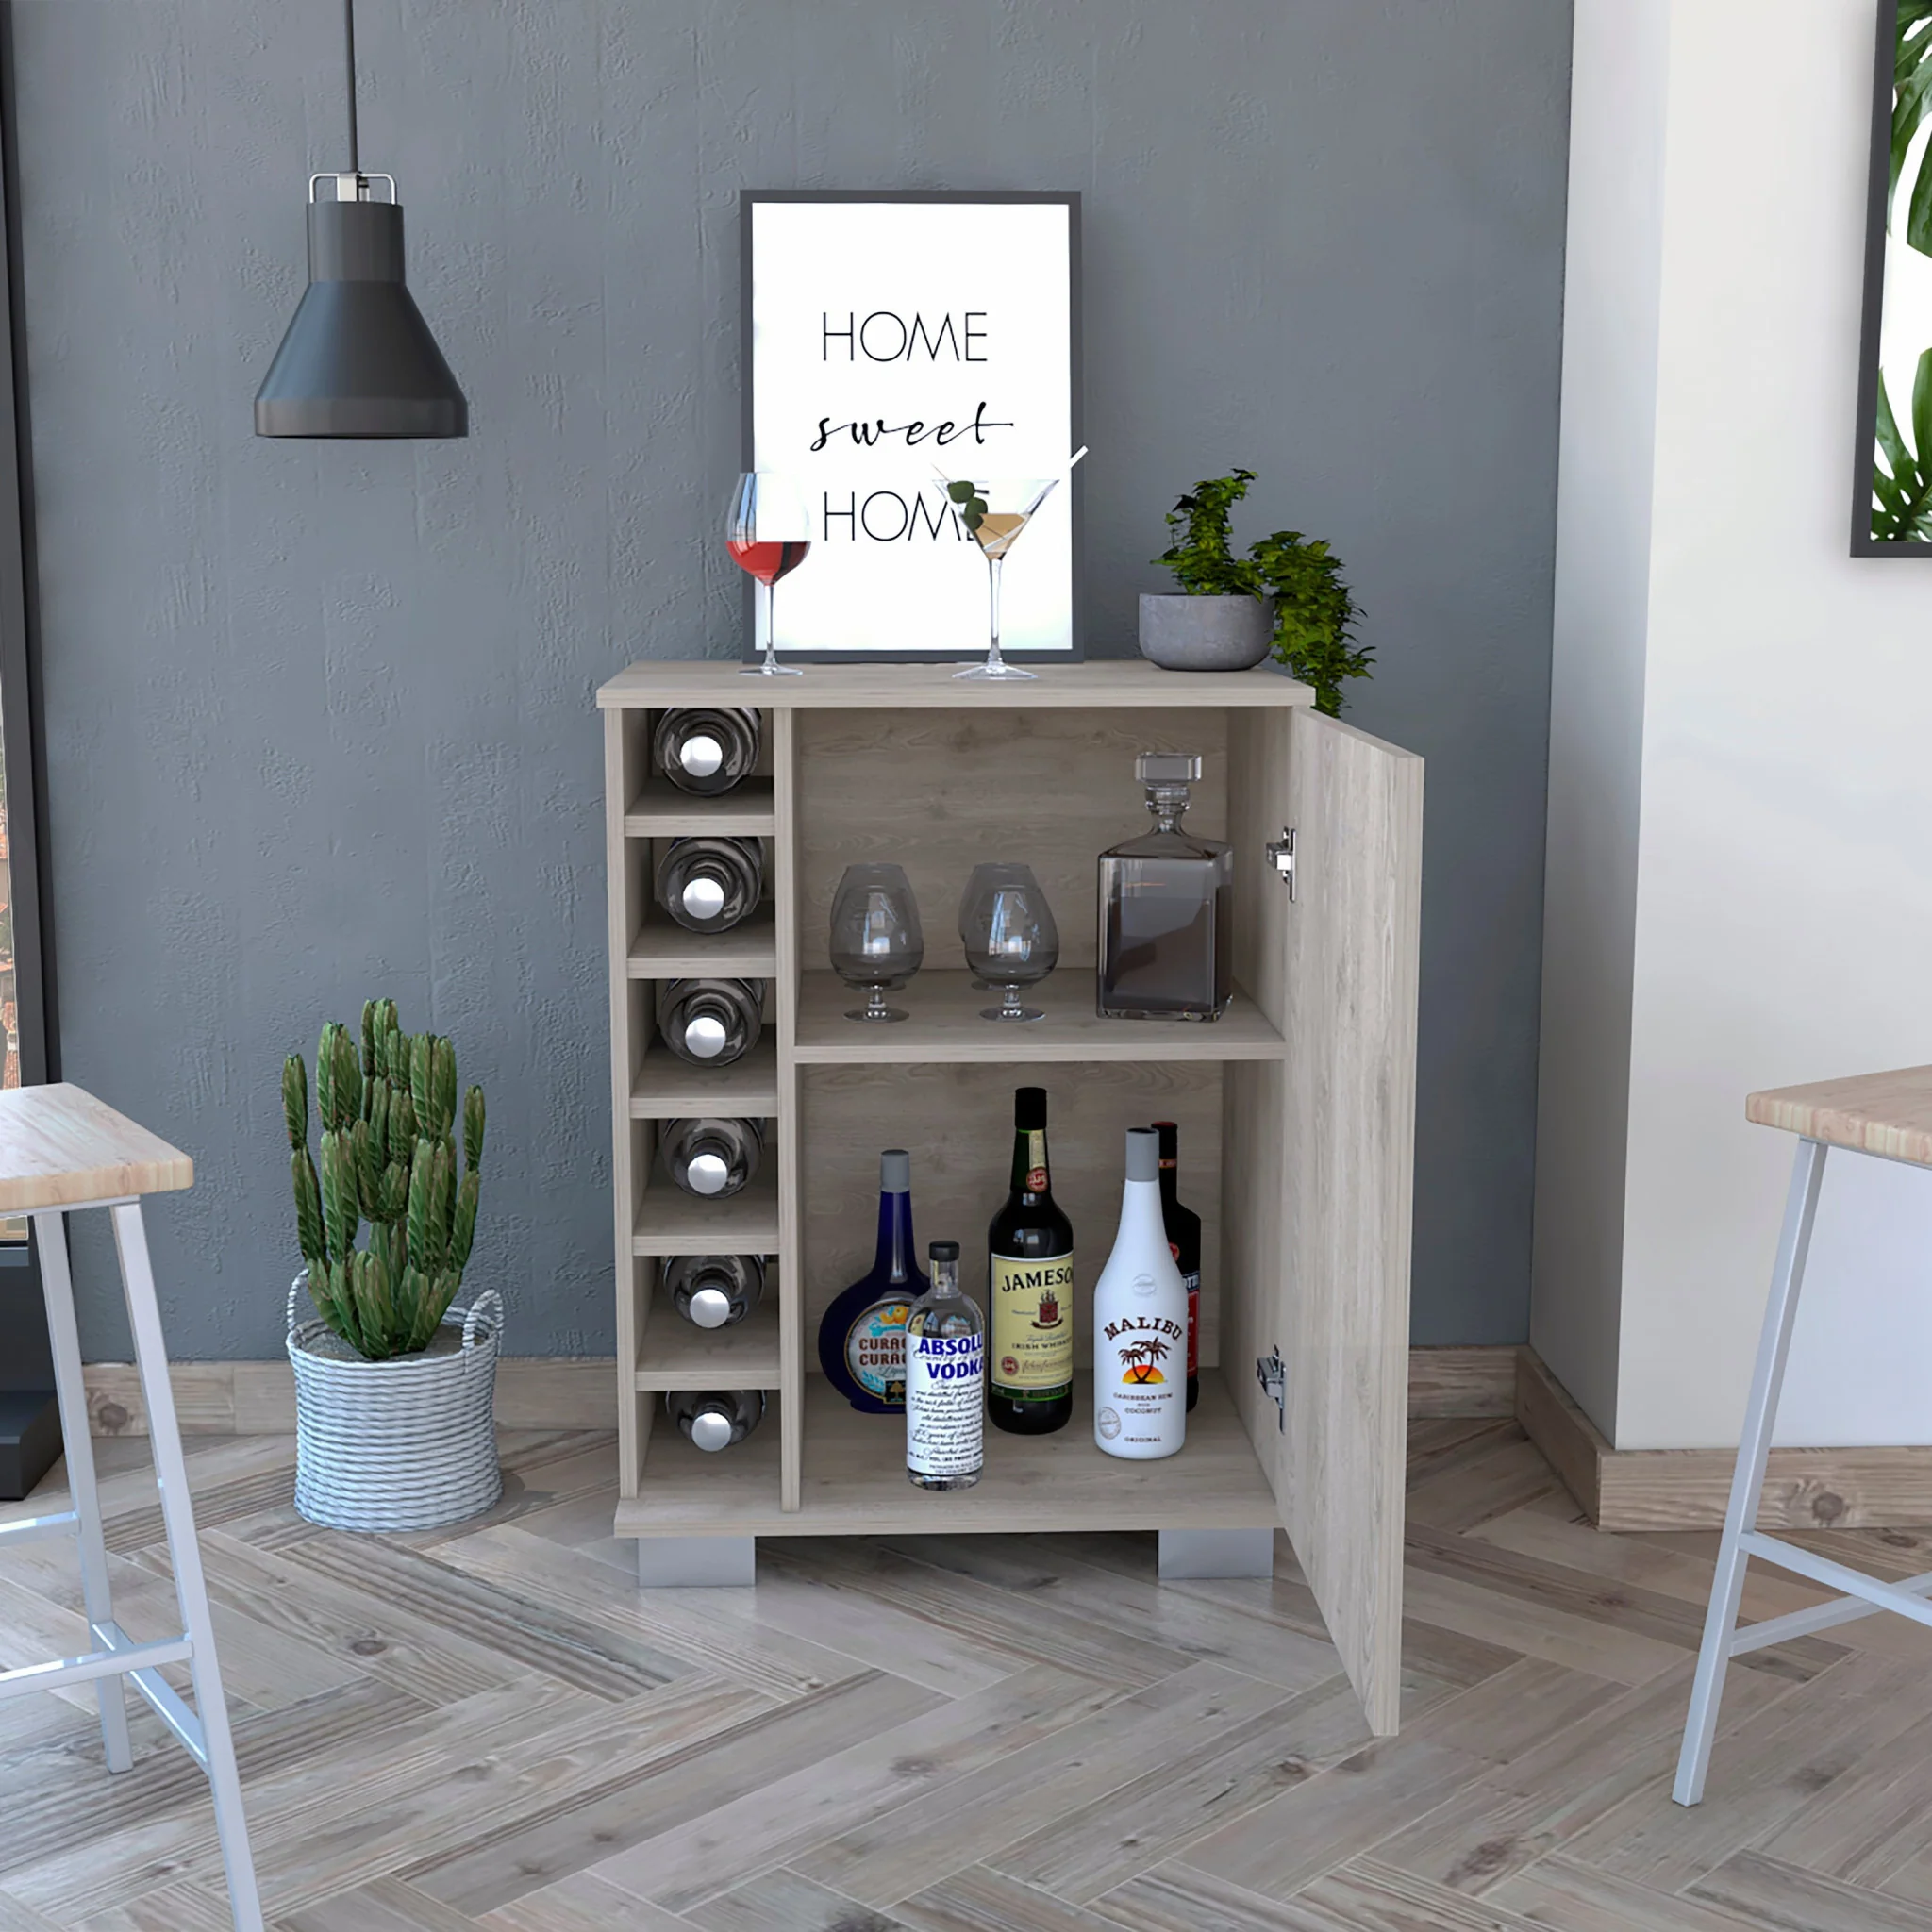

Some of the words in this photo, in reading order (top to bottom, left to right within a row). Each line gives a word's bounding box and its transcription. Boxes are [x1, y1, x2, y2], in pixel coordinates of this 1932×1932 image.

[823, 311, 988, 362] HOME
[810, 401, 1014, 452] sweet
[1103, 1316, 1183, 1341] MALIBU
